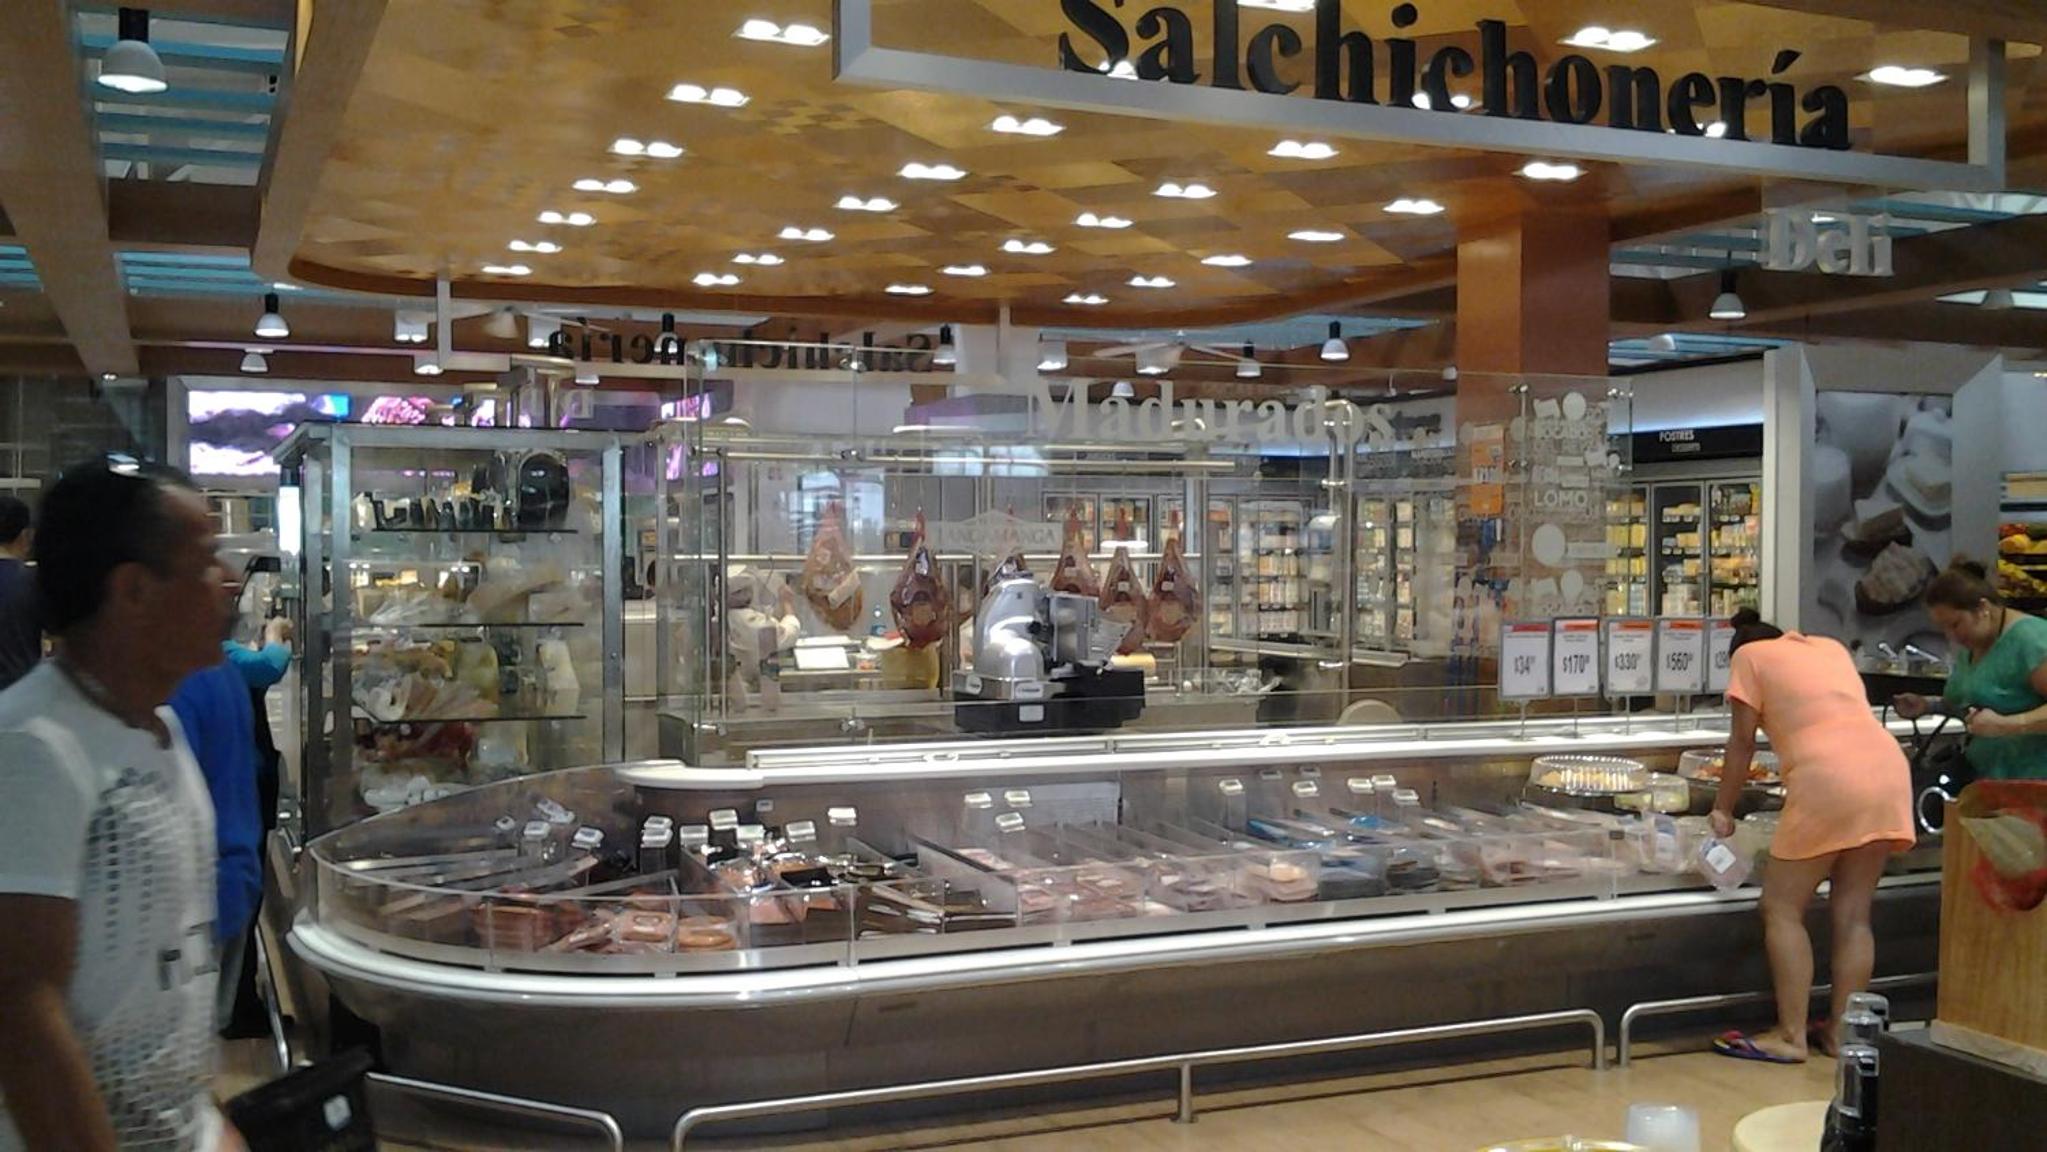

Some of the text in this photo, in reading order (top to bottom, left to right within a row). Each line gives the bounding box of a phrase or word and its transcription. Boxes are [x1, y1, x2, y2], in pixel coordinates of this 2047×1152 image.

[1059, 0, 1852, 150] Salchichonería
[1762, 207, 1895, 277] Deli
[1028, 378, 1397, 450] Madurados
[1658, 429, 1695, 443] POSTRES
[1533, 490, 1589, 507] LOMO
